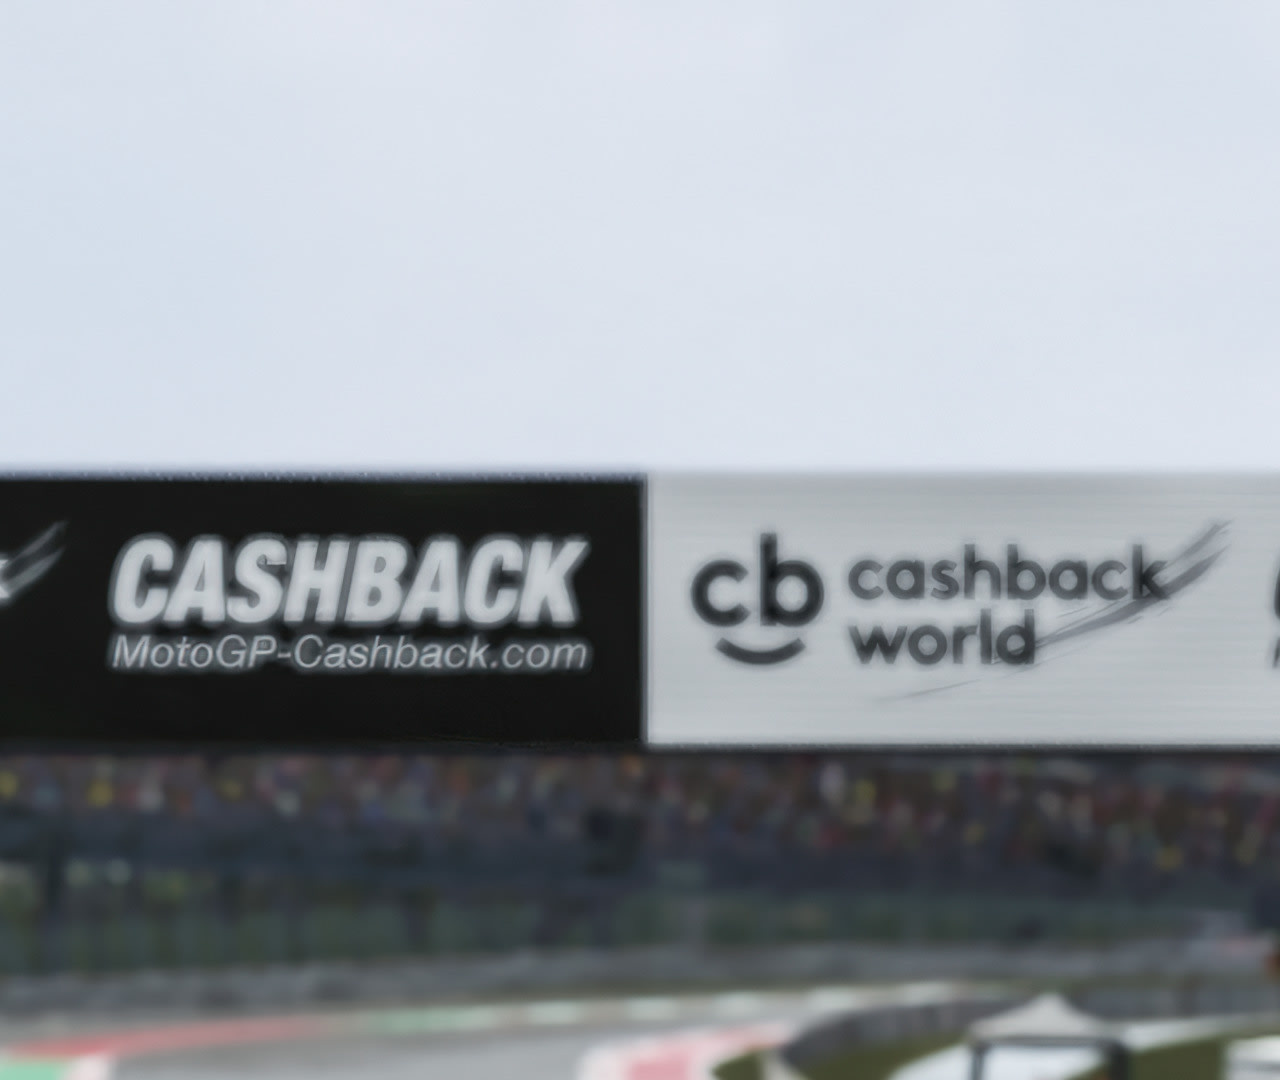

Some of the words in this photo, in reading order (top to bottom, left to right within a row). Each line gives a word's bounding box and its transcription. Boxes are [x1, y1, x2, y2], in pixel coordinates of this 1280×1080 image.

[111, 536, 588, 627] CASHBACK
[690, 533, 825, 630] cb
[847, 543, 1170, 601] cashback
[112, 633, 588, 670] MotoGP-Cashback.com
[848, 608, 1036, 667] world
